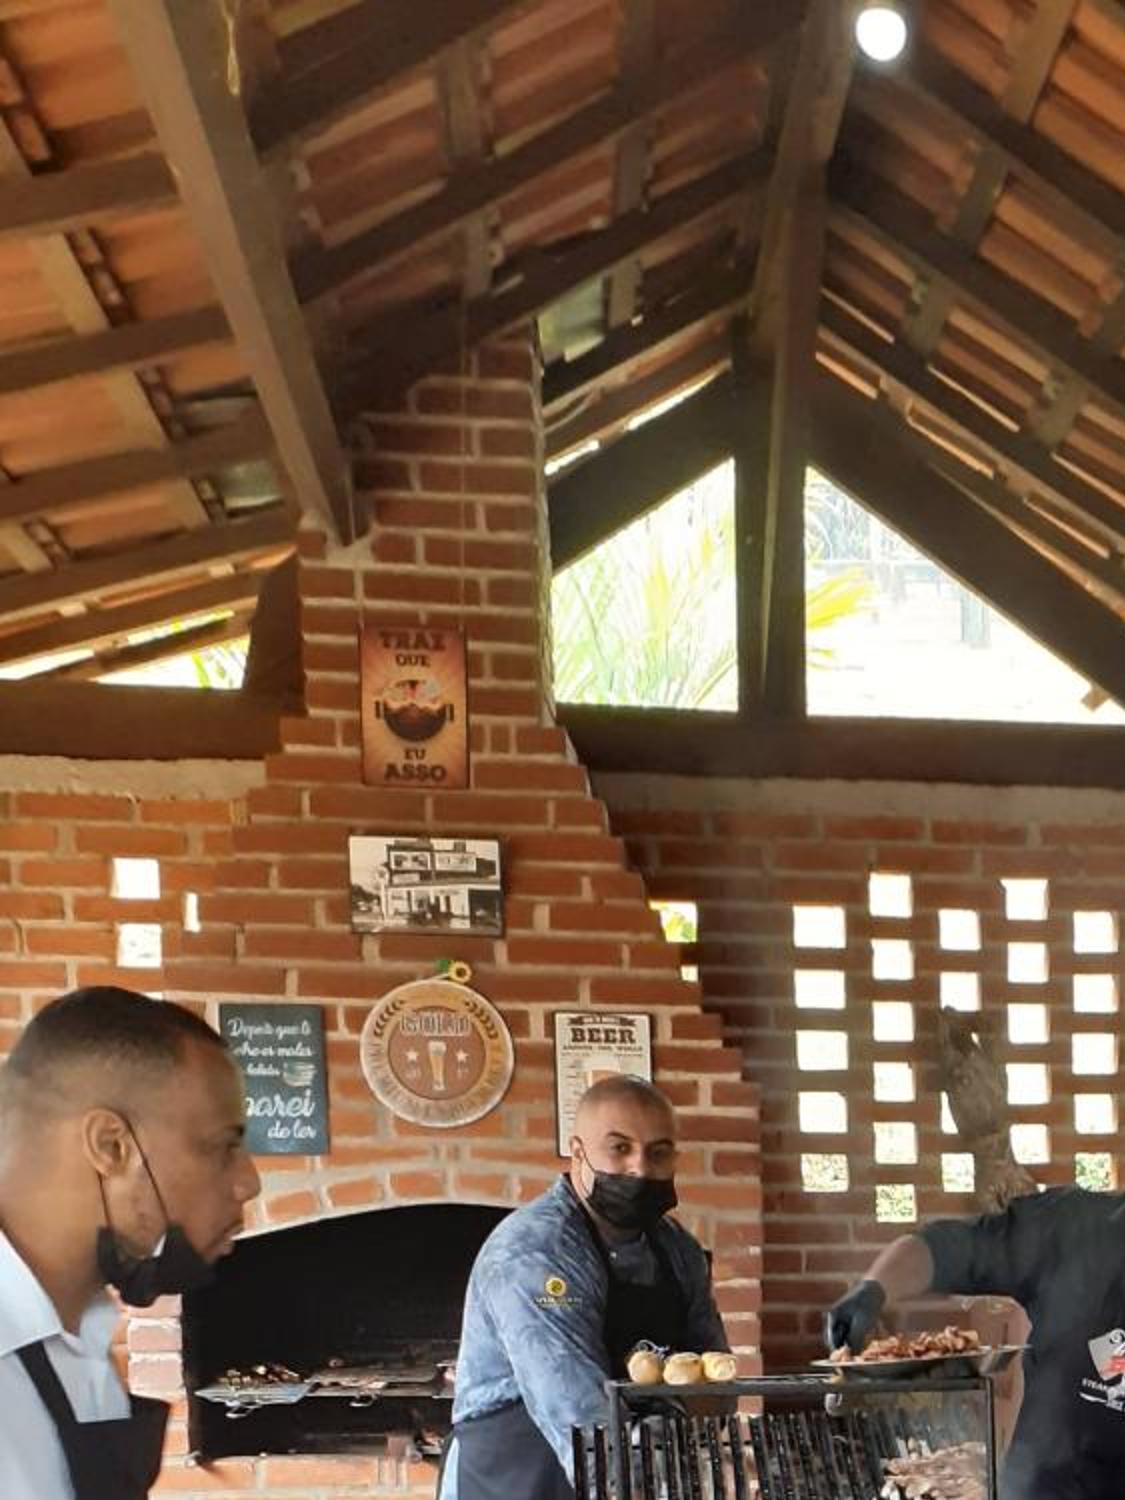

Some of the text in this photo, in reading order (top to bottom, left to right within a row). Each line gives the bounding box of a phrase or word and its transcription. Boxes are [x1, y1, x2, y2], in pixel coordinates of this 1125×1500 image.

[380, 631, 446, 649] TRAZ
[396, 654, 430, 667] QUE
[404, 749, 425, 760] EU
[385, 763, 447, 781] ASSO
[571, 1028, 636, 1044] BEER
